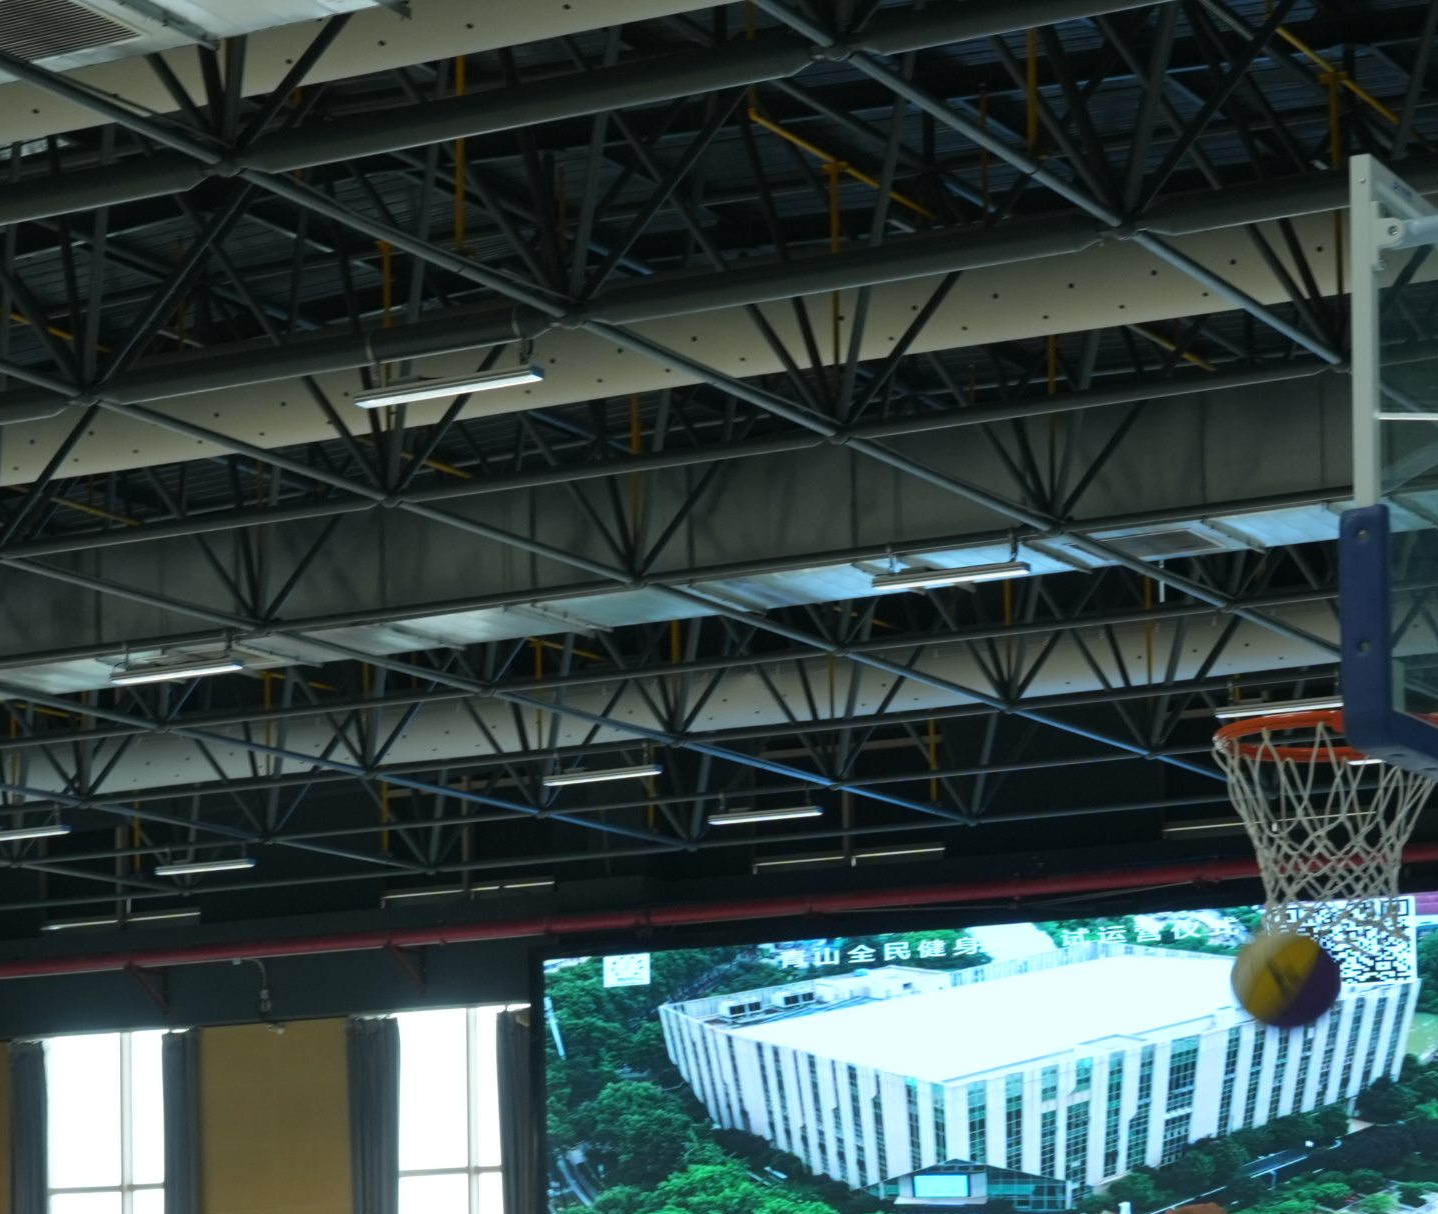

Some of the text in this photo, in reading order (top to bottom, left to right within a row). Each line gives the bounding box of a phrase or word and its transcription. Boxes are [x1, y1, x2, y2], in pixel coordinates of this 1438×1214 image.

[780, 916, 1240, 968] 青山全民健身 试运营仪式
